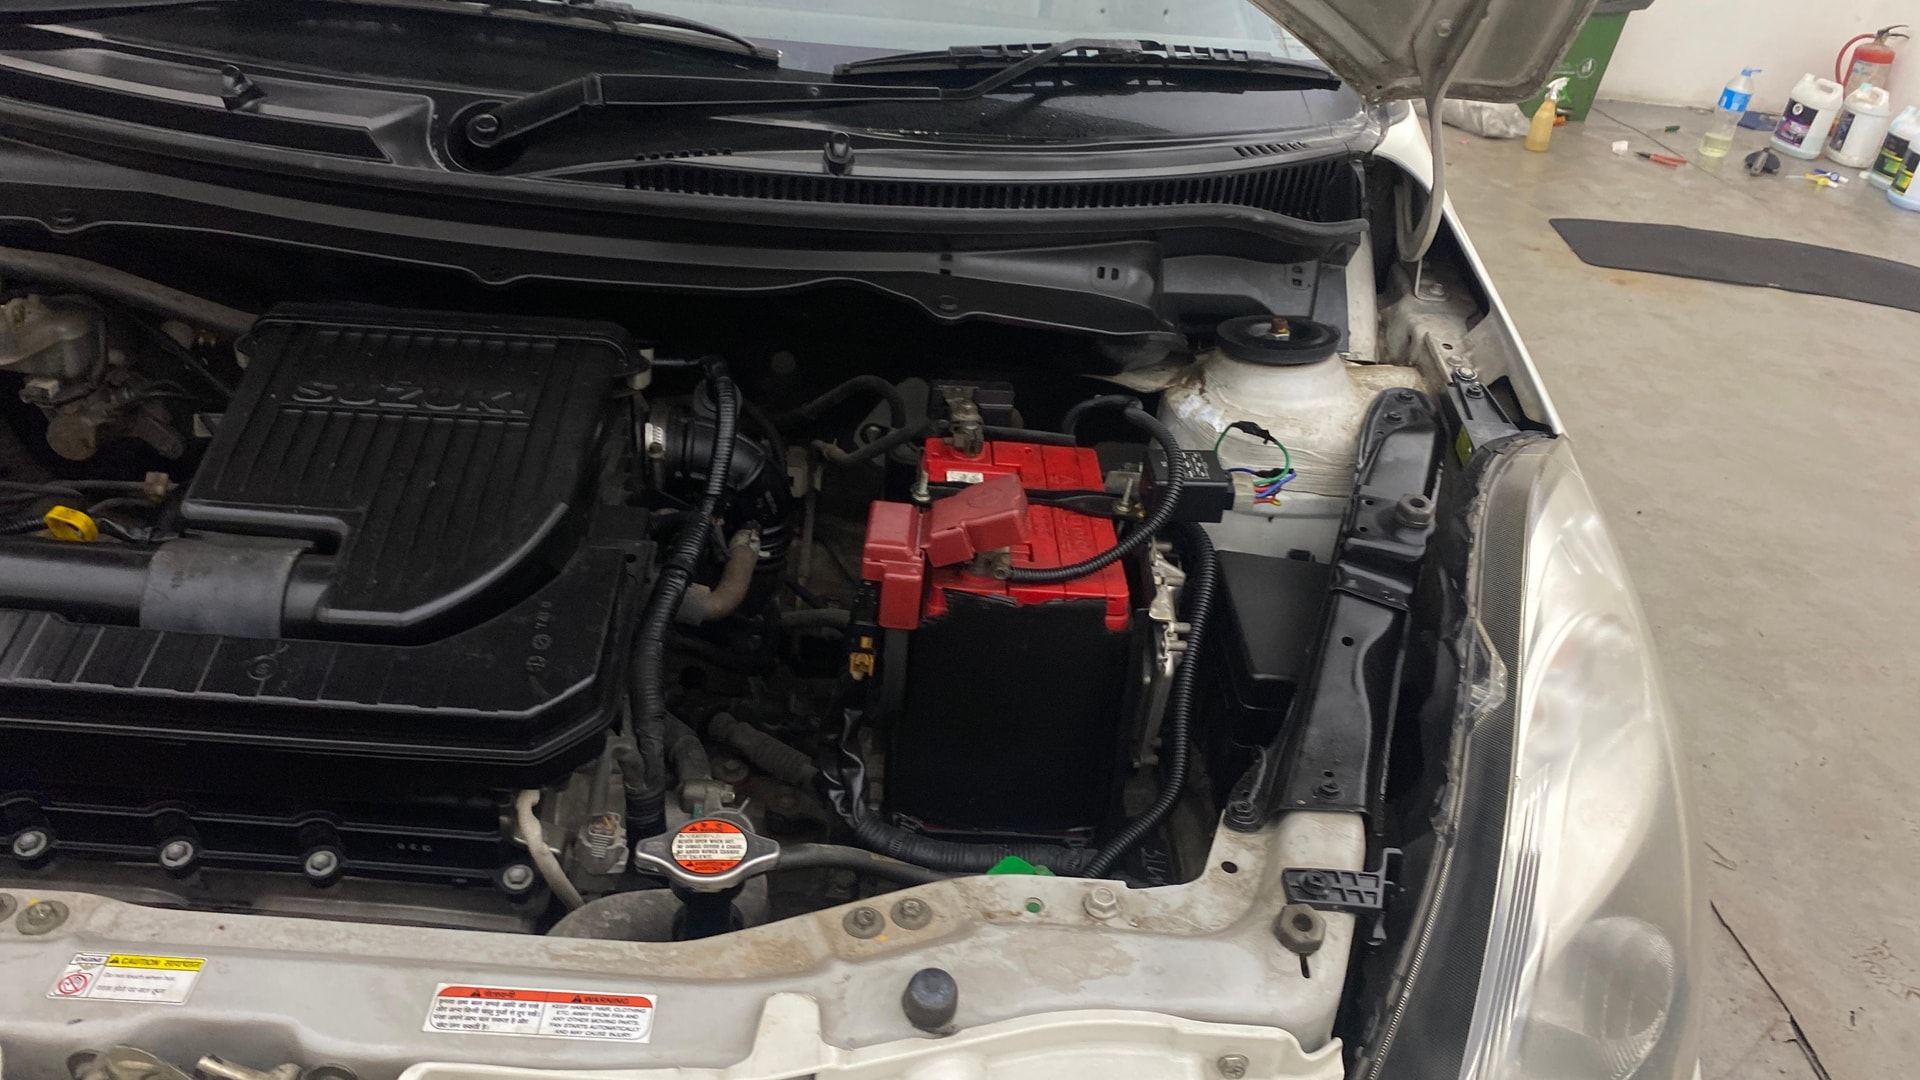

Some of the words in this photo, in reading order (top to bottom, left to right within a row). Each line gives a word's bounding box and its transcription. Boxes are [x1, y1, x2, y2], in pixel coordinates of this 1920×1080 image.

[291, 380, 529, 415] SUZUKI
[120, 957, 160, 966] CAUTION
[585, 996, 629, 1004] WARNING
[590, 1024, 640, 1032] AUTOMATICALLY
